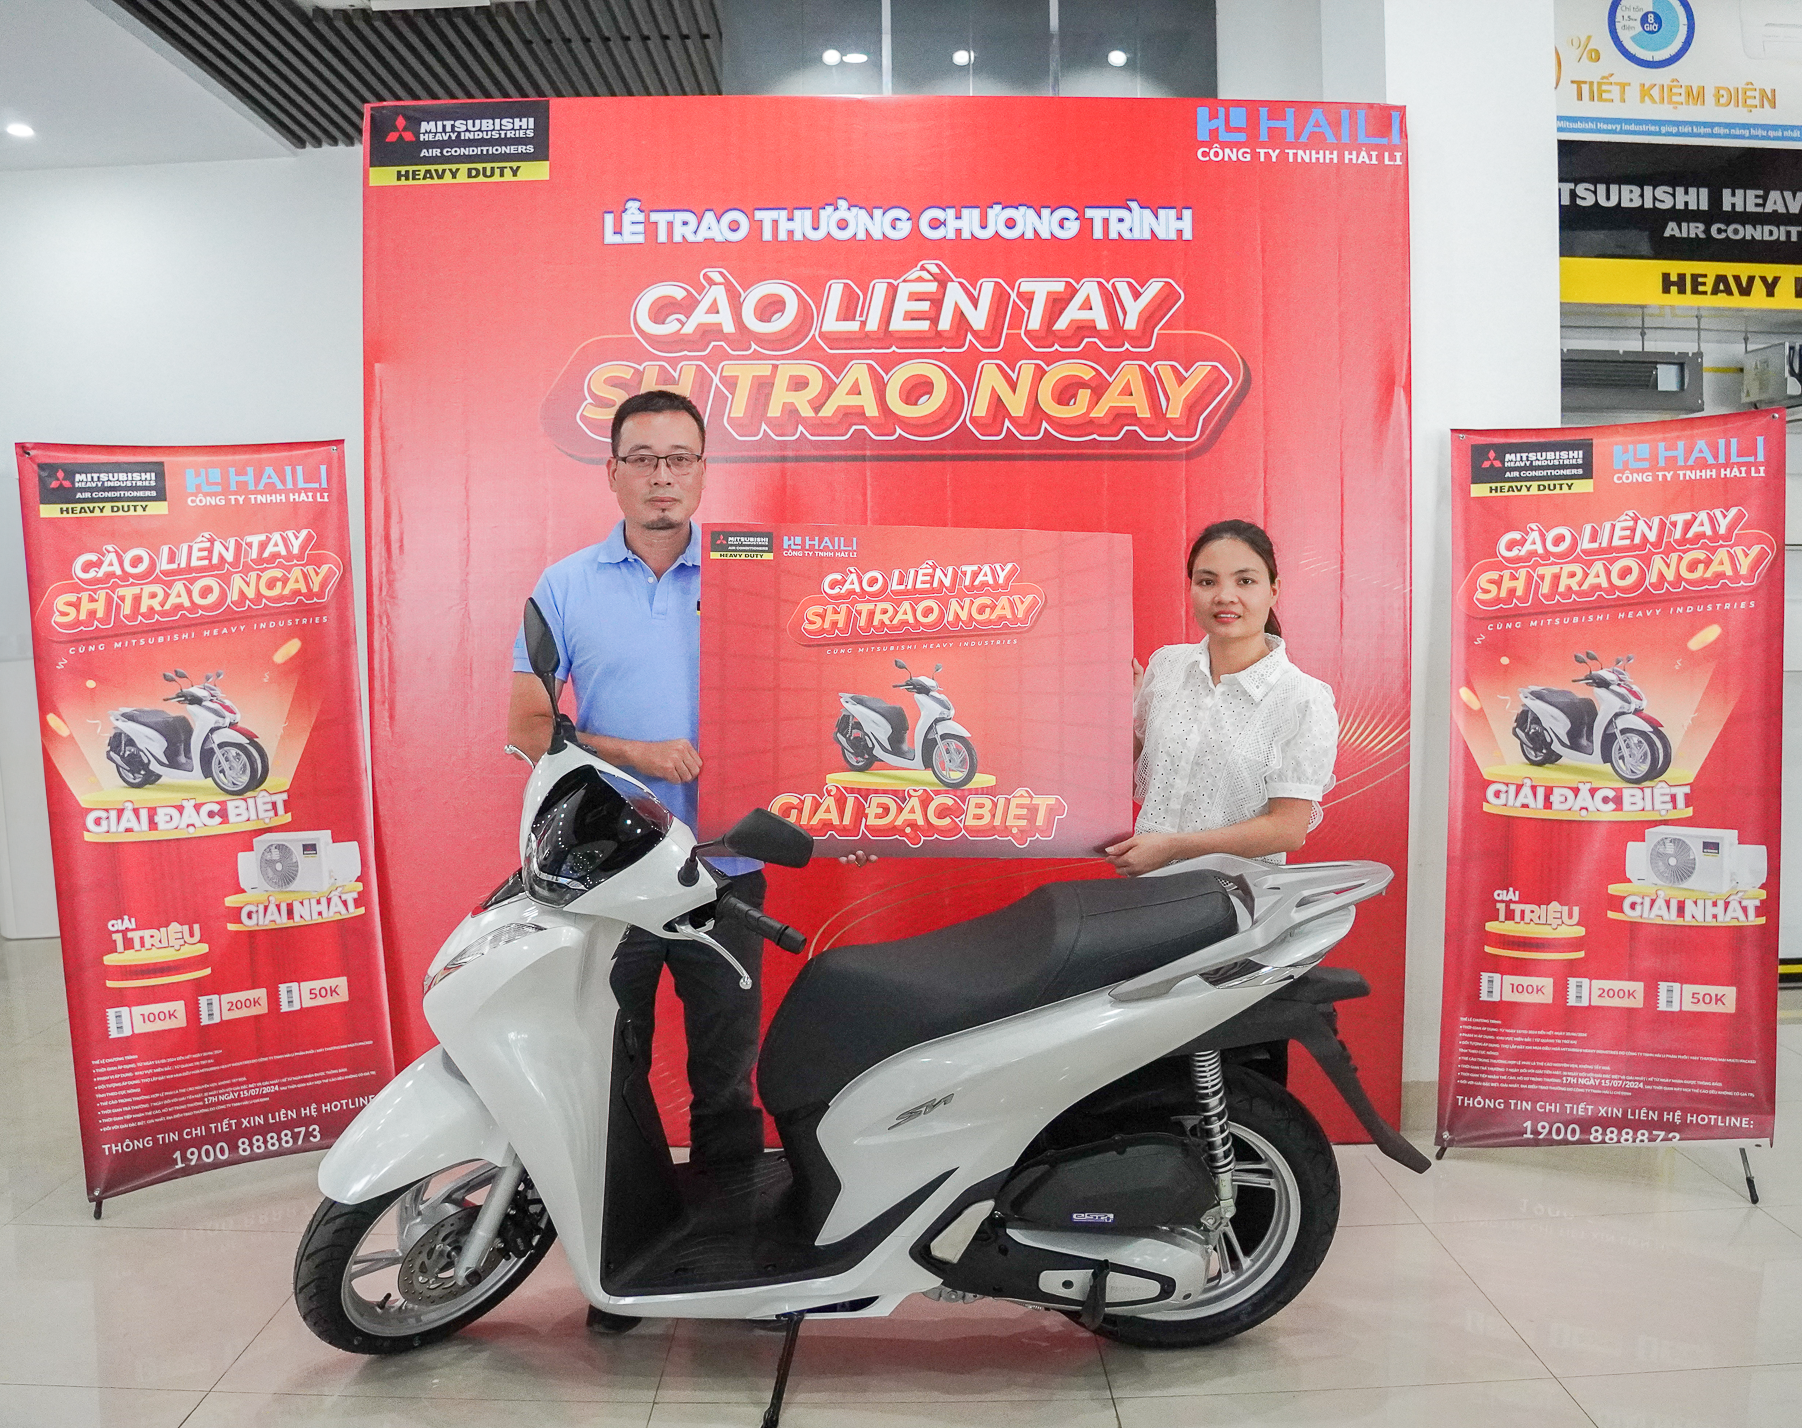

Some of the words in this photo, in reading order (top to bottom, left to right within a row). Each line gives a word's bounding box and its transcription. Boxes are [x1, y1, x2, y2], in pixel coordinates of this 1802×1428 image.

[1644, 23, 1658, 31] GIỜ
[1647, 13, 1654, 23] 8
[1570, 73, 1631, 103] TIẾT
[1639, 78, 1705, 110] KIỆM
[1713, 82, 1776, 114] ĐIỆN
[419, 117, 535, 133] MITSUBISHI
[419, 132, 458, 141] HEAVY
[460, 129, 535, 140] INDUSTRIES
[1258, 107, 1402, 145] HAILI
[1557, 121, 1596, 129] Mitsubishi
[1597, 122, 1621, 131] Heavy
[1622, 121, 1660, 131] Industries
[1661, 124, 1677, 133] giúp
[1679, 125, 1692, 133] tiết
[1693, 126, 1712, 135] kiệm
[1713, 126, 1729, 135] điện
[1731, 128, 1749, 137] năng
[1751, 127, 1767, 136] hiệu
[1768, 129, 1782, 137] quả
[419, 148, 441, 157] AIR
[442, 145, 535, 156] CONDITIONERS
[1196, 143, 1251, 162] CÔNG
[1255, 148, 1281, 163] TY
[1285, 148, 1338, 164] TNHH
[1344, 147, 1378, 165] HẢI
[1384, 152, 1403, 165] LI
[396, 168, 460, 182] HEAVY
[467, 165, 521, 179] DUTY
[603, 198, 645, 244] LỄ
[649, 208, 750, 243] TRAO
[754, 197, 912, 242] THƯỞNG
[918, 202, 1081, 240] CHƯƠNG
[1085, 198, 1193, 241] TRÌNH
[1663, 221, 1706, 239] AIR
[1661, 272, 1781, 298] HEAVY
[633, 269, 806, 345] CÀO
[819, 262, 1004, 341] LIỀN
[1016, 280, 1174, 340] TAY
[718, 361, 957, 428] TRAO
[969, 362, 1222, 429] NGAY
[1505, 450, 1583, 461] MITSUBISHI
[1658, 436, 1764, 467] HAILI
[75, 472, 156, 481] MITSUBISHI
[228, 465, 329, 491] HAILI
[1520, 469, 1583, 477] CONDITIONERS
[1613, 471, 1653, 483] CÔNG
[1656, 471, 1674, 481] TY
[1677, 469, 1716, 480] TNHH
[1721, 465, 1747, 478] HẢI
[1750, 467, 1765, 477] LI
[92, 490, 157, 498] CONDITIONERS
[187, 494, 225, 506] CÔNG
[228, 495, 245, 505] TY
[248, 493, 286, 504] TNHH
[289, 490, 314, 502] HẢI
[316, 492, 329, 502] LI
[1489, 485, 1533, 494] HEAVY
[1537, 483, 1574, 491] DUTY
[60, 505, 106, 515] HEAVY
[110, 504, 149, 513] DUTY
[805, 537, 857, 550] HAILI
[1498, 523, 1576, 561] CÀO
[1580, 511, 1664, 554] LIỀN
[1670, 508, 1743, 544] TAY
[74, 545, 155, 583] CÀO
[159, 533, 240, 575] LIỀN
[245, 529, 311, 563] TAY
[822, 567, 886, 598] CÀO
[890, 561, 956, 594] LIỀN
[961, 563, 1017, 590] TAY
[1476, 570, 1533, 605] SH
[1537, 558, 1643, 599] TRAO
[1649, 547, 1766, 588] NGAY
[53, 591, 112, 627] SH
[116, 579, 225, 620] TRAO
[230, 565, 334, 606] NGAY
[803, 605, 851, 634] SH
[856, 600, 943, 630] TRAO
[947, 595, 1037, 626] NGAY
[1487, 620, 1522, 631] CÙNG
[1529, 613, 1611, 627] MITSUBISHI
[1618, 607, 1662, 620] HEAVY
[1669, 601, 1756, 614] INDUSTRIES
[69, 641, 106, 655] CÙNG
[114, 632, 195, 649] MITSUBISHI
[203, 624, 247, 637] HEAVY
[253, 615, 329, 631] INDUSTRIES
[1486, 777, 1545, 810] GIẢI
[1550, 781, 1617, 817] ĐẶC
[1622, 780, 1691, 816] BIỆT
[85, 801, 149, 833] GIẢI
[154, 798, 223, 834] ĐẶC
[226, 790, 288, 824] BIỆT
[770, 785, 861, 832] GIẢI
[864, 788, 959, 840] ĐẶC
[964, 789, 1062, 840] BIỆT
[1493, 887, 1520, 901] GIẢI
[240, 896, 287, 927] GIẢI
[293, 886, 358, 923] NHẤT
[1496, 903, 1506, 922] 1
[1510, 900, 1579, 930] TRIỆU
[1622, 889, 1678, 921] GIẢI
[1684, 890, 1761, 923] NHẤT
[107, 915, 136, 931] GIẢI
[112, 933, 124, 953] 1
[127, 922, 201, 951] TRIỆU
[309, 985, 340, 1000] 50K
[1509, 982, 1546, 996] 100K
[1597, 987, 1637, 1000] 200K
[1690, 992, 1726, 1006] 50K
[227, 997, 262, 1012] 200K
[140, 1009, 178, 1024] 100K
[1562, 1076, 1577, 1084] 17H
[1578, 1076, 1600, 1086] NGÀY
[1601, 1080, 1644, 1089] 15/07/2024
[204, 1095, 218, 1105] 17H
[219, 1089, 238, 1101] NGÀY
[240, 1085, 279, 1098] 15/07/2024
[1456, 1095, 1505, 1109] THÔNG
[1508, 1099, 1532, 1112] TIN
[1536, 1101, 1560, 1113] CHI
[1564, 1102, 1595, 1116] TIẾT
[1598, 1106, 1622, 1118] XIN
[1627, 1107, 1658, 1122] LIÊN
[1663, 1110, 1682, 1125] HỆ
[1686, 1114, 1754, 1128] HOTLINE:
[102, 1133, 153, 1156] THÔNG
[157, 1130, 179, 1145] TIN
[183, 1126, 206, 1140] CHI
[209, 1118, 237, 1135] TIẾT
[241, 1114, 266, 1129] XIN
[268, 1108, 297, 1123] LIÊN
[301, 1103, 318, 1119] HỆ
[1522, 1120, 1581, 1142] 1900
[172, 1141, 230, 1169] 1900
[237, 1124, 321, 1156] 888873
